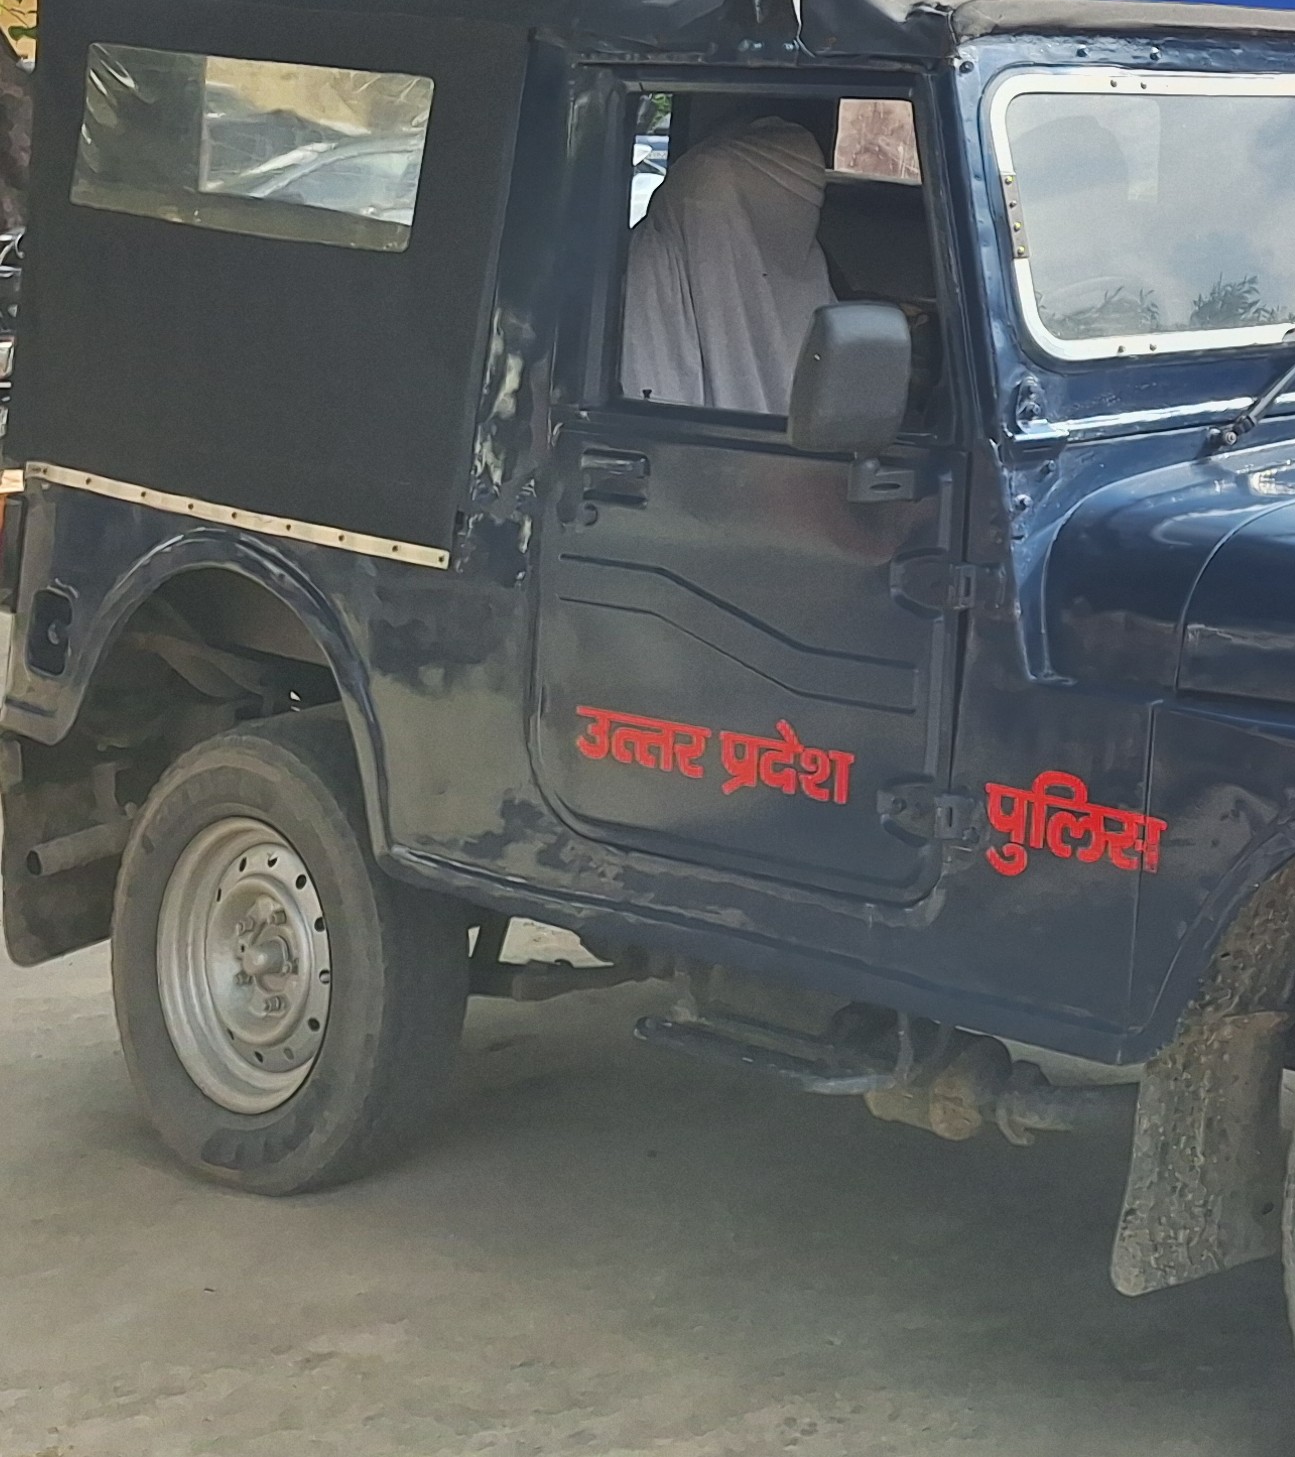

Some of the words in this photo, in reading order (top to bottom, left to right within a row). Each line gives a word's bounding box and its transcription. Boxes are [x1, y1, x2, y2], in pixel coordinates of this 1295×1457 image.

[576, 705, 711, 779] उत्तर
[720, 719, 855, 804] प्रदेश
[985, 770, 1168, 877] पुलिस
